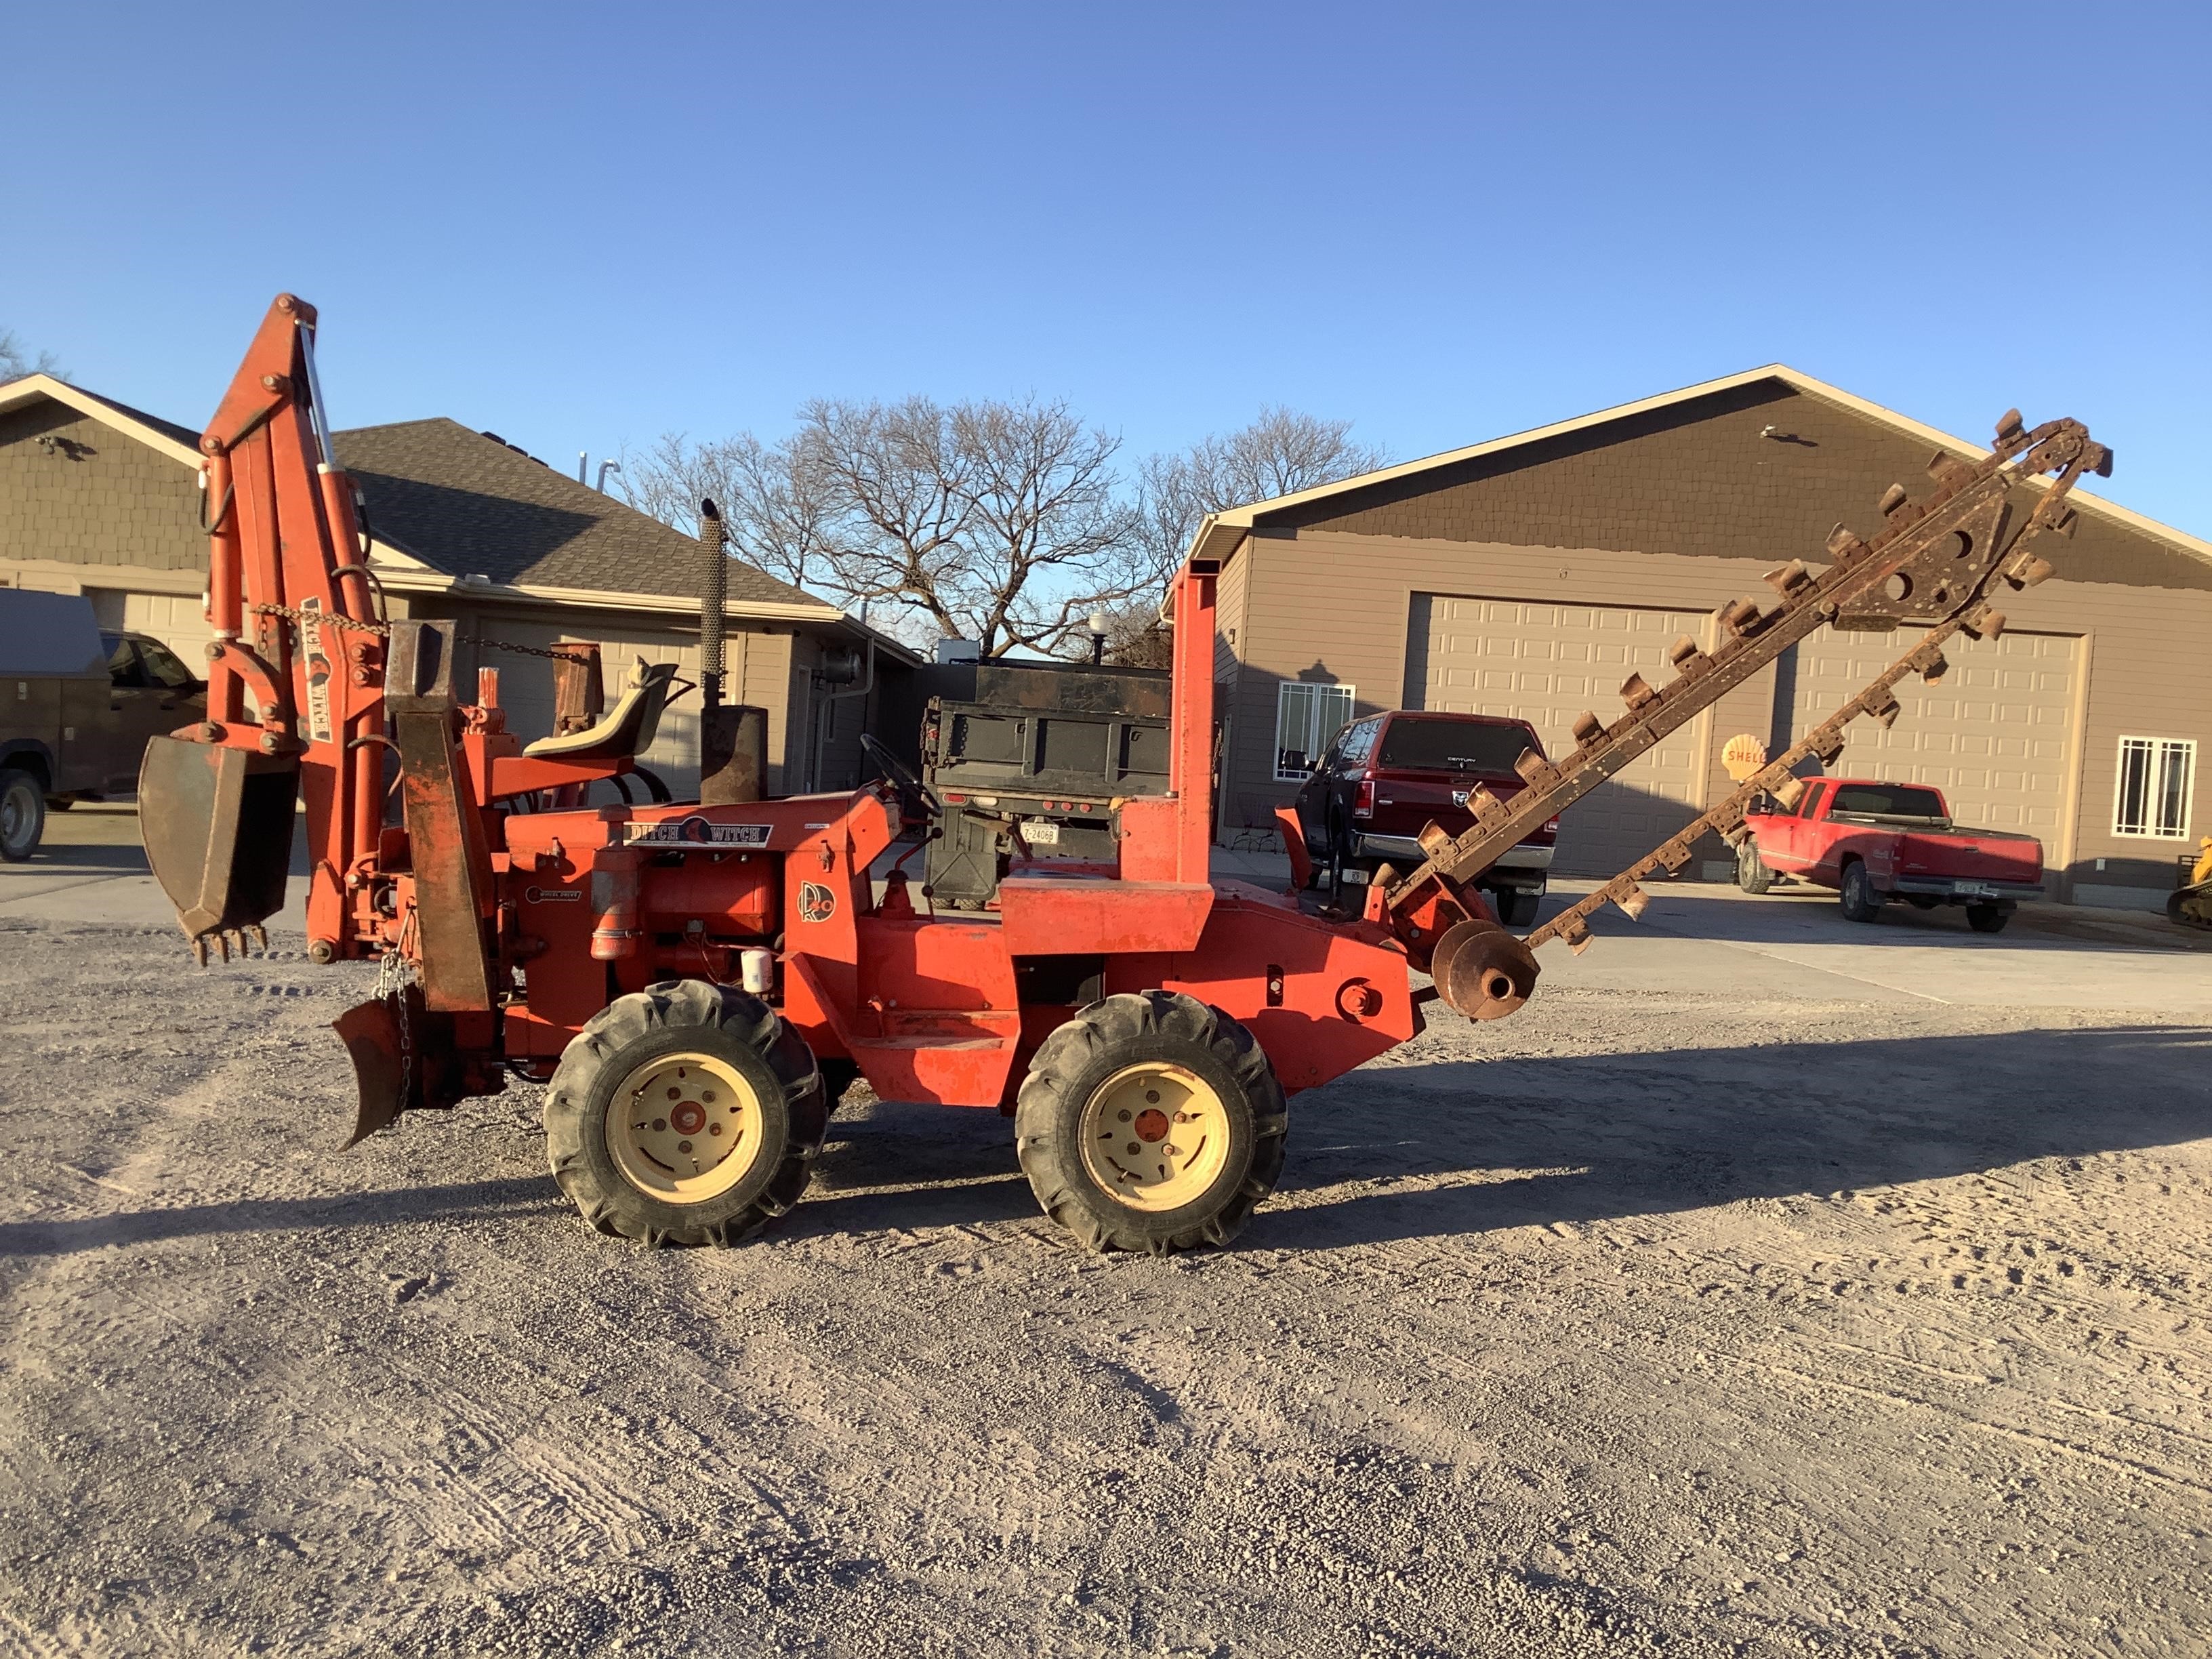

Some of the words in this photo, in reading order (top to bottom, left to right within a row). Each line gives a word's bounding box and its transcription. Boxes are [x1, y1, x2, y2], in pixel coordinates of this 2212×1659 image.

[312, 684, 329, 733] WITCH
[1727, 750, 1766, 764] SHELL
[630, 825, 679, 841] DITCH
[710, 826, 760, 842] WITCH
